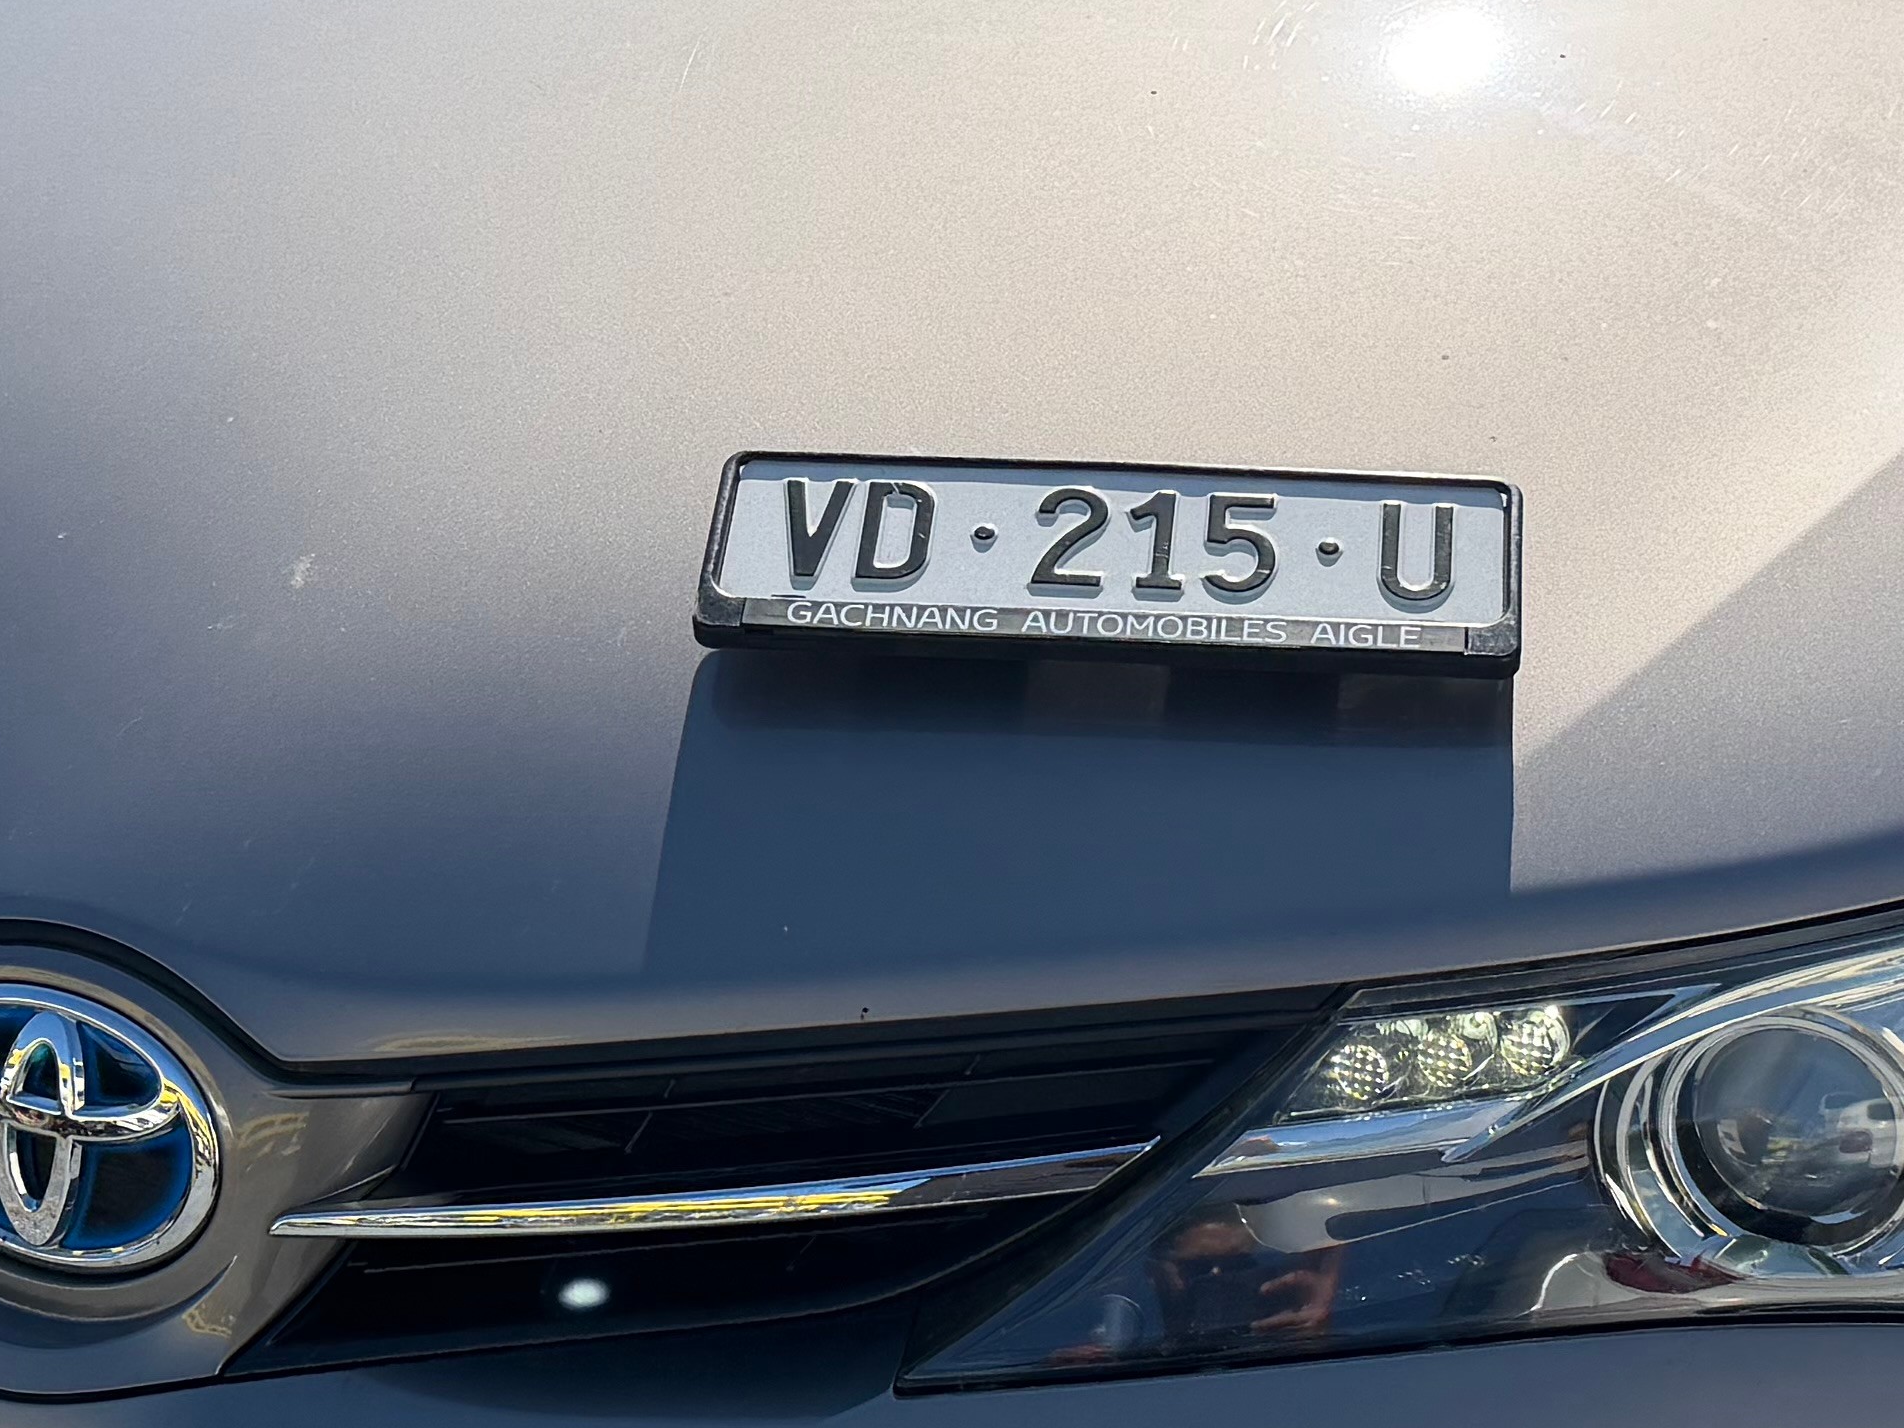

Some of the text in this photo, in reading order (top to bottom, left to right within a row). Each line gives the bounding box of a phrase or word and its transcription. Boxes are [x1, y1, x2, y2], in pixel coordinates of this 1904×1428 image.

[786, 599, 1423, 649] GACHNANG AUTOMOBILES AIGLE
